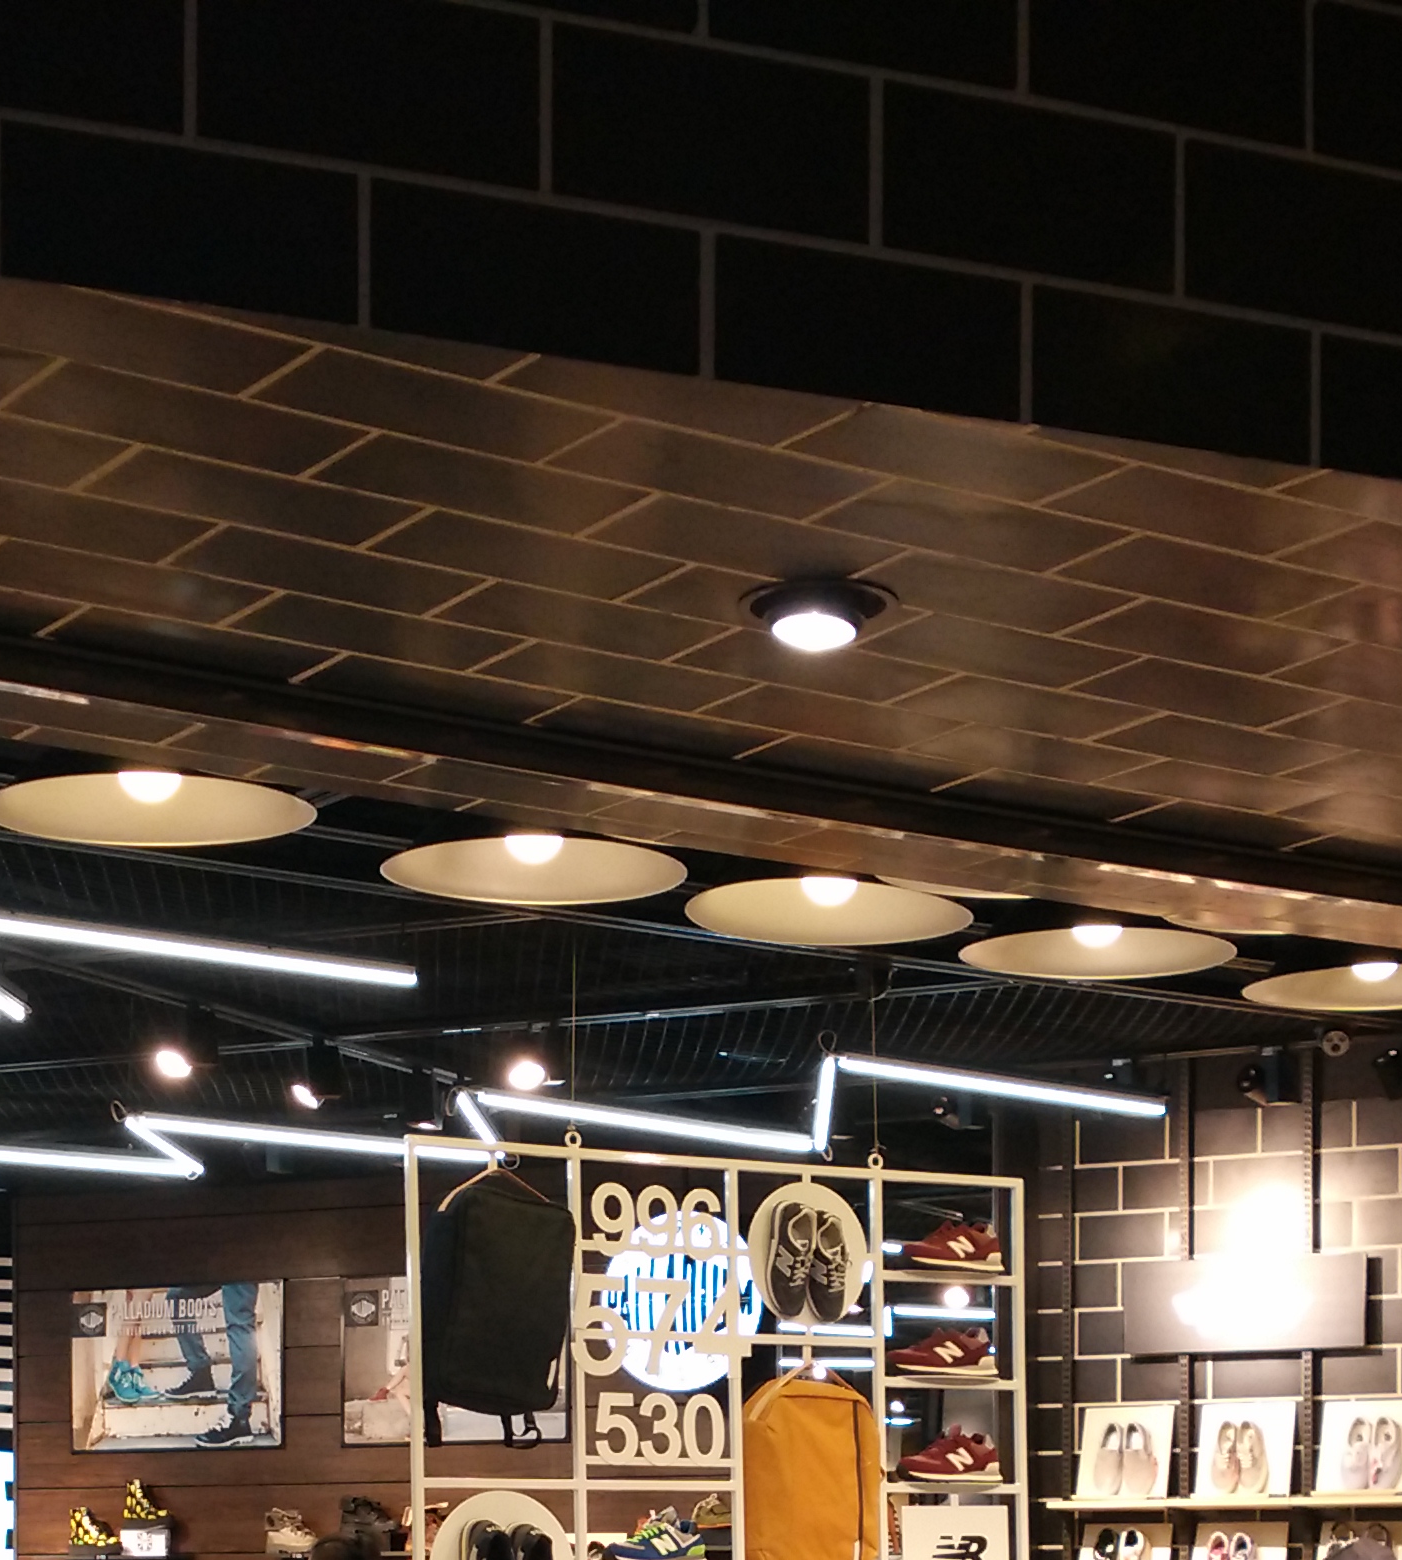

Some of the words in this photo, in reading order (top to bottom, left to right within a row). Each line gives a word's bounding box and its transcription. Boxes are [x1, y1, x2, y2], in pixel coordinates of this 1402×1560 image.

[591, 1182, 721, 1261] 996
[110, 1300, 175, 1320] PALLADIUM
[178, 1298, 217, 1318] BOOTS
[571, 1274, 752, 1378] 574
[595, 1392, 725, 1466] 530
